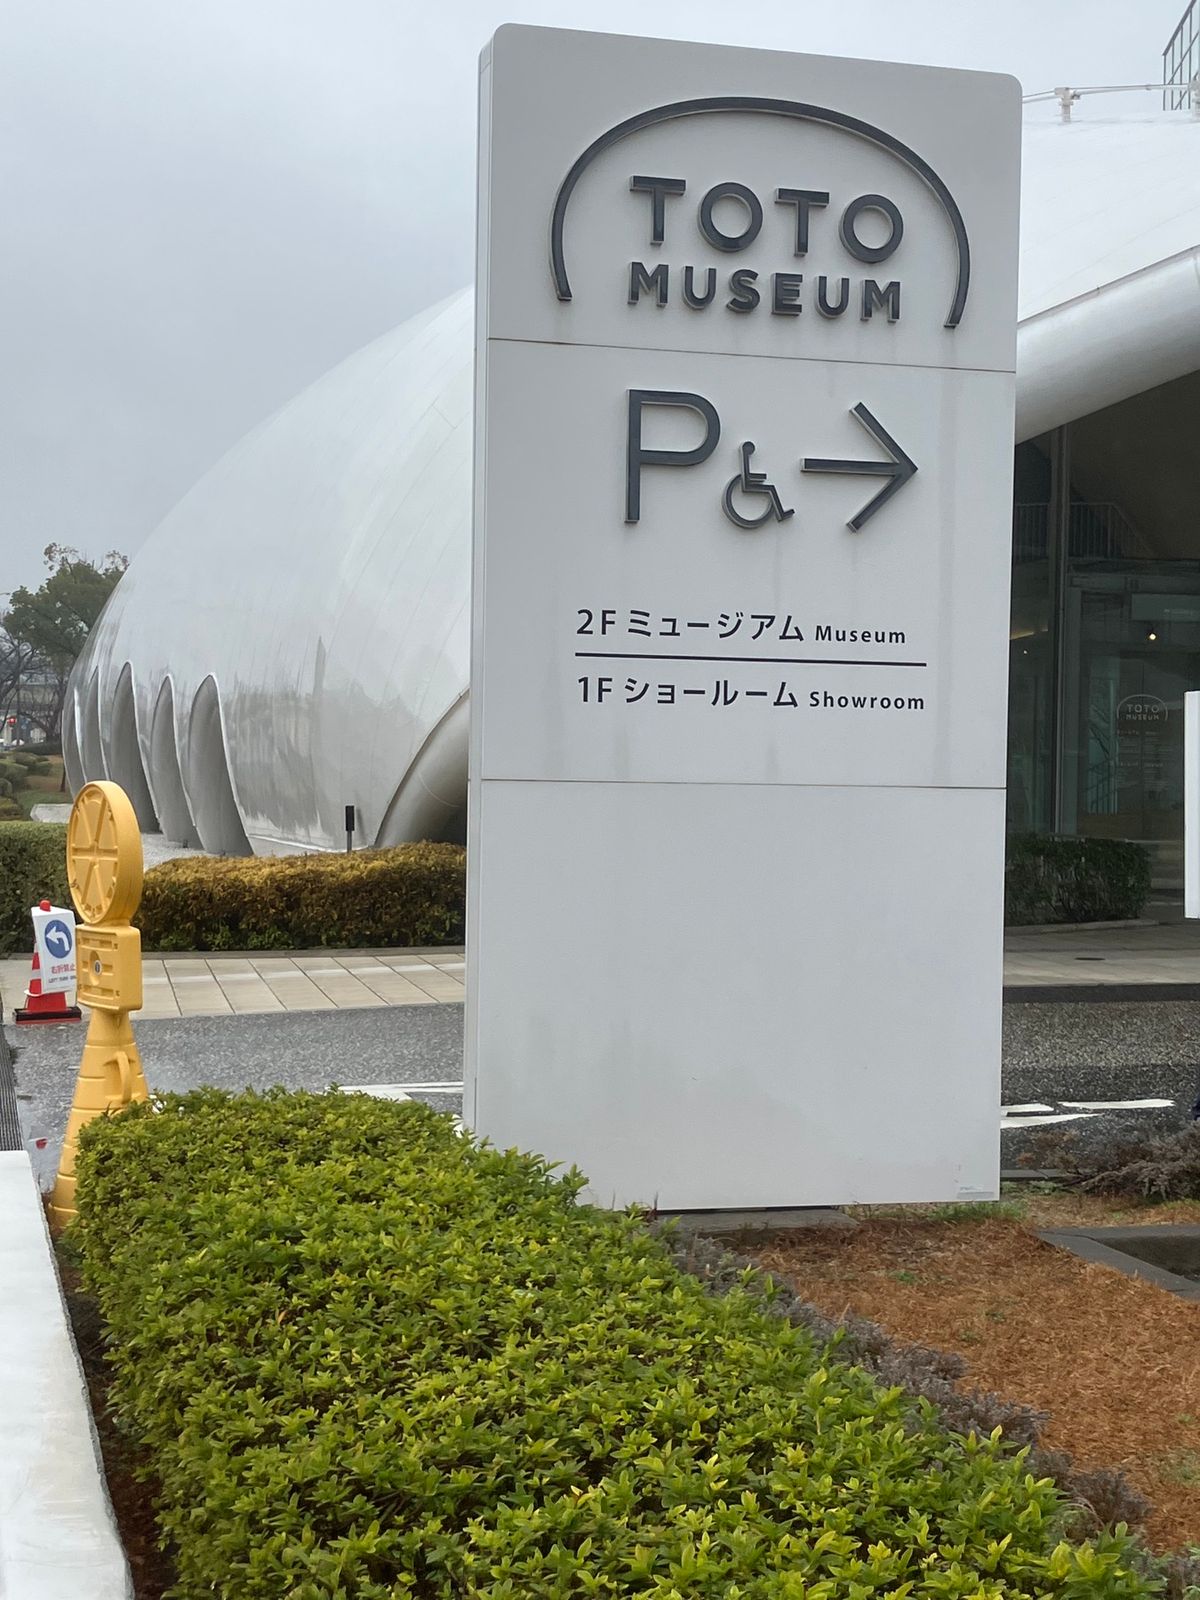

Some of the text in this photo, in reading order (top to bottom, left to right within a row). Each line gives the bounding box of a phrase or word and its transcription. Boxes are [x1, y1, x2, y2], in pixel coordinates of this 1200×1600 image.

[629, 175, 904, 263] TOTO
[627, 261, 901, 323] MUSEUM
[624, 388, 721, 524] P
[815, 625, 907, 644] Museum
[809, 690, 925, 710] Showroom
[1127, 703, 1160, 713] TOTO
